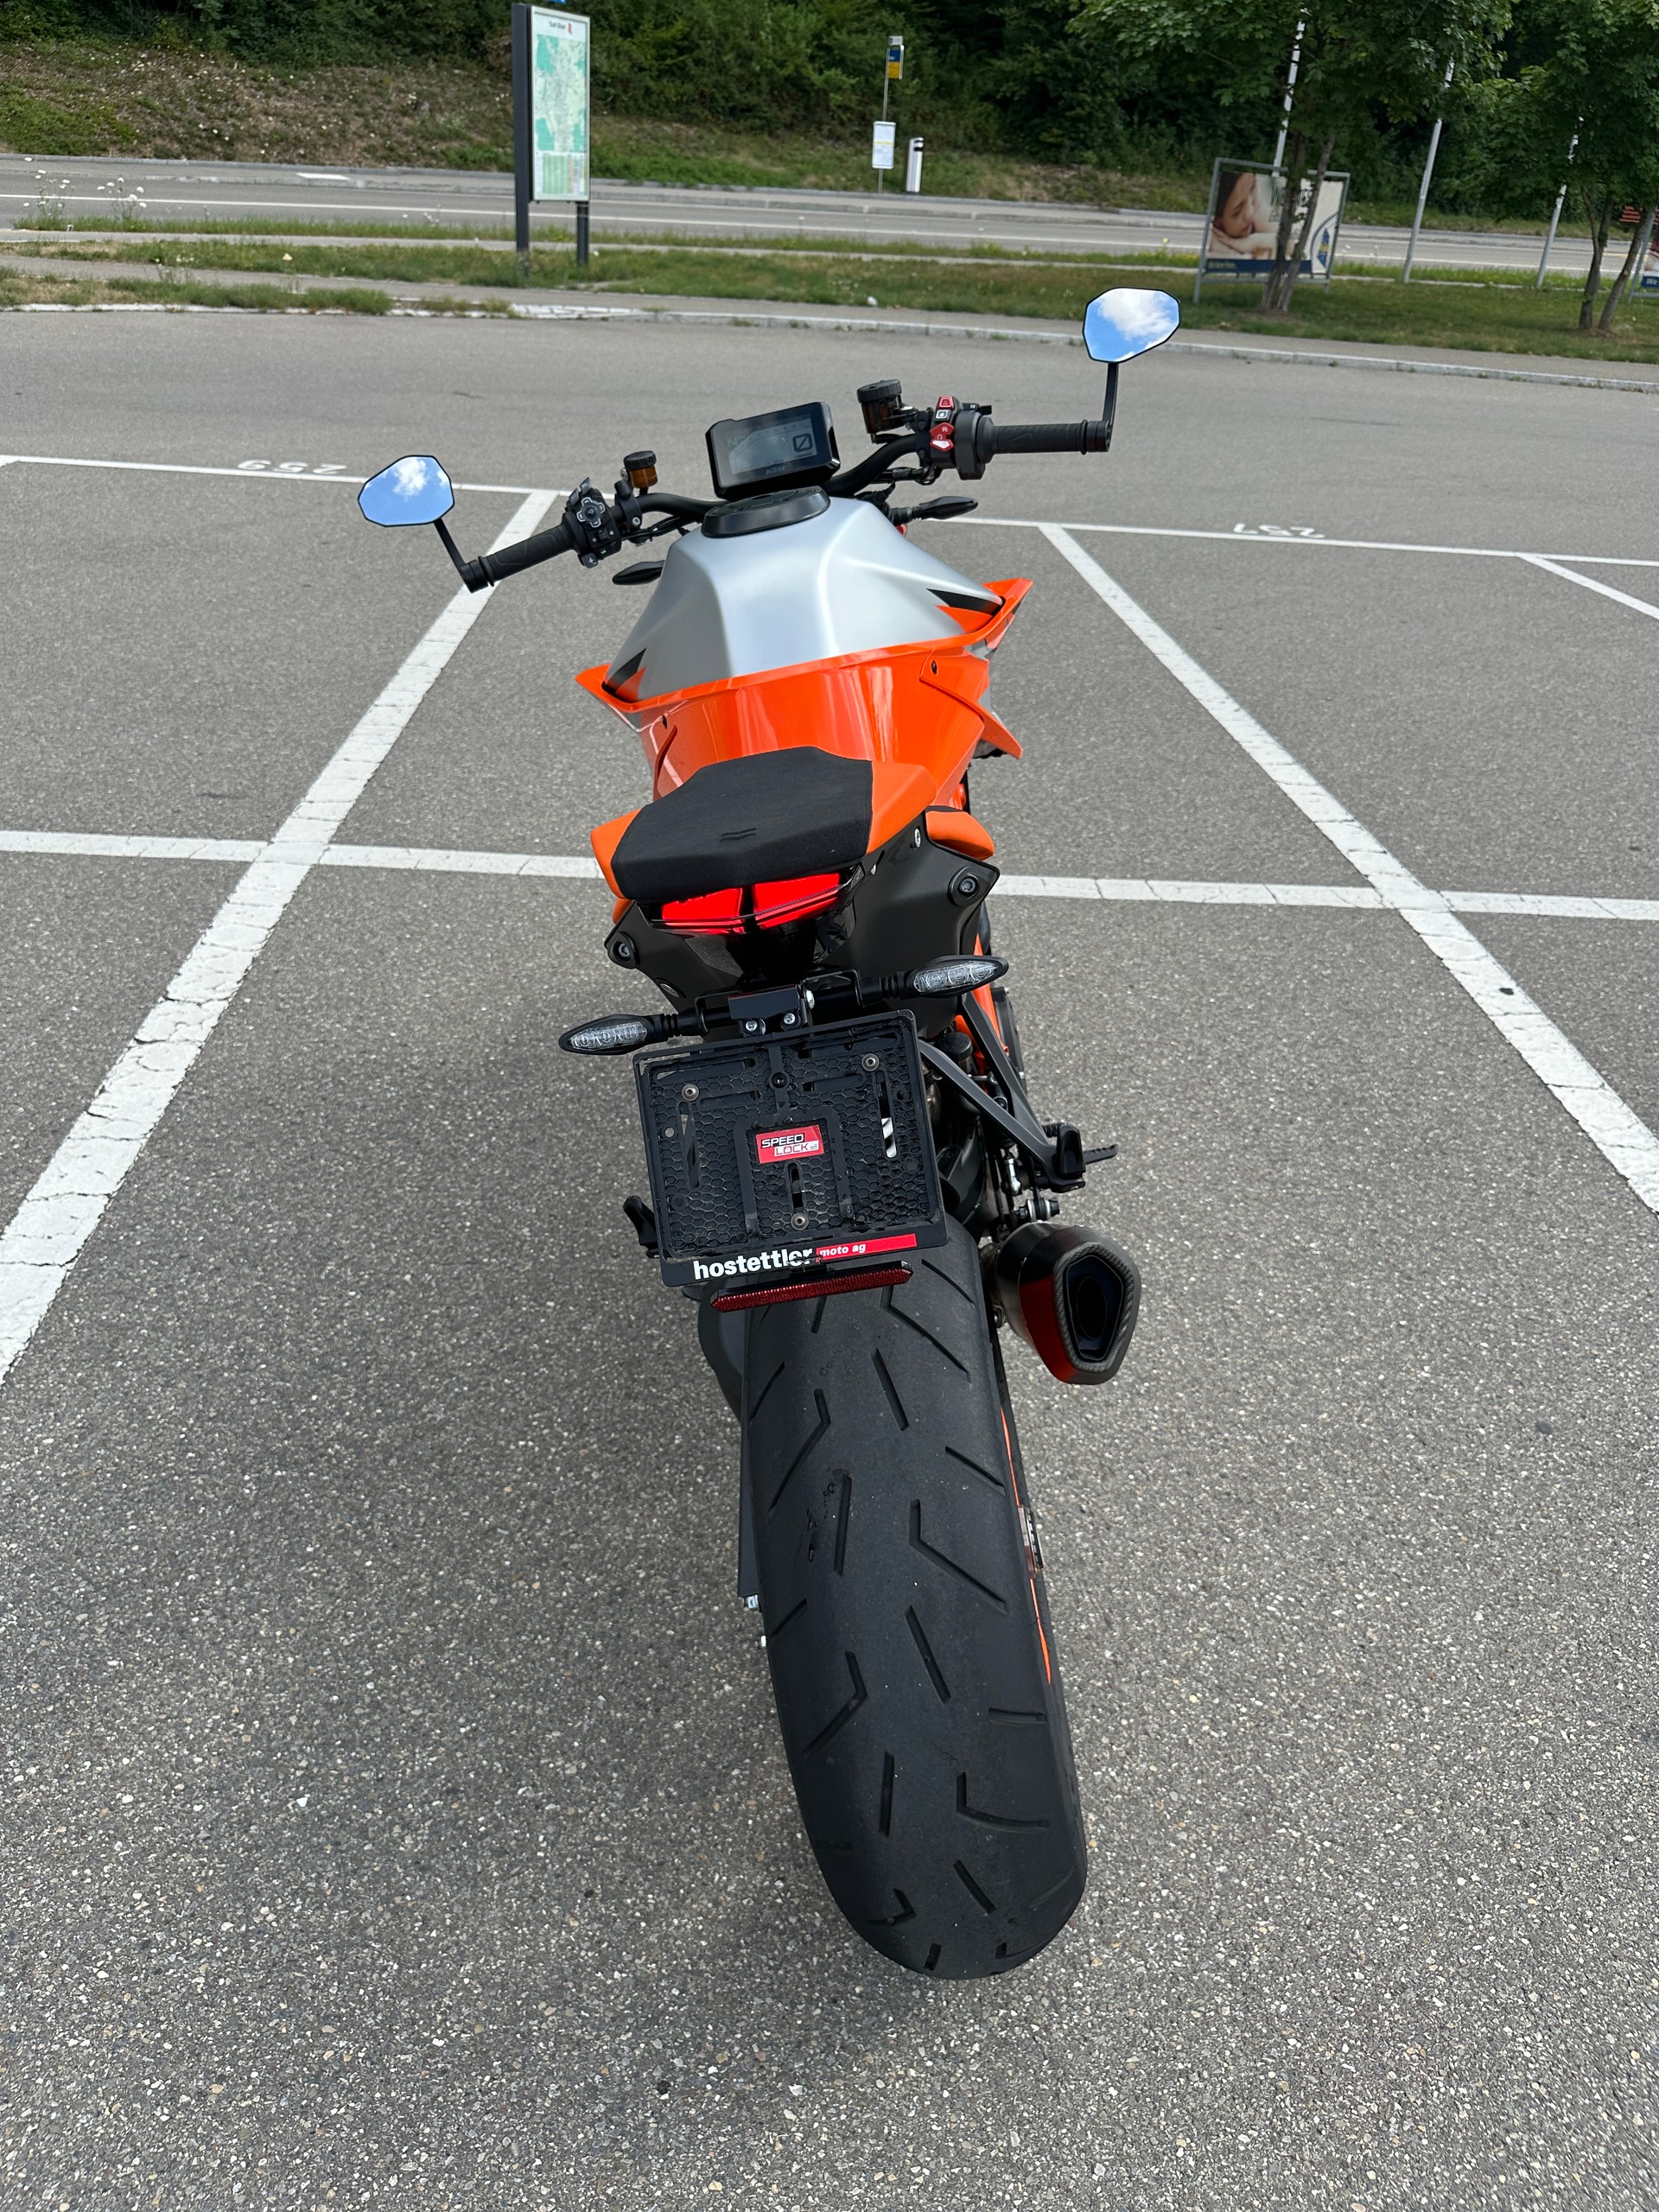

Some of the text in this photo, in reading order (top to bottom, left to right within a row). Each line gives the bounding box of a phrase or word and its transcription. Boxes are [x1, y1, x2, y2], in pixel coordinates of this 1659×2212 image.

[238, 459, 346, 474] 259
[1233, 523, 1325, 537] 257
[761, 1134, 804, 1148] SPEED
[776, 1143, 809, 1155] LOCK
[694, 1243, 866, 1280] hostettler moto ag
